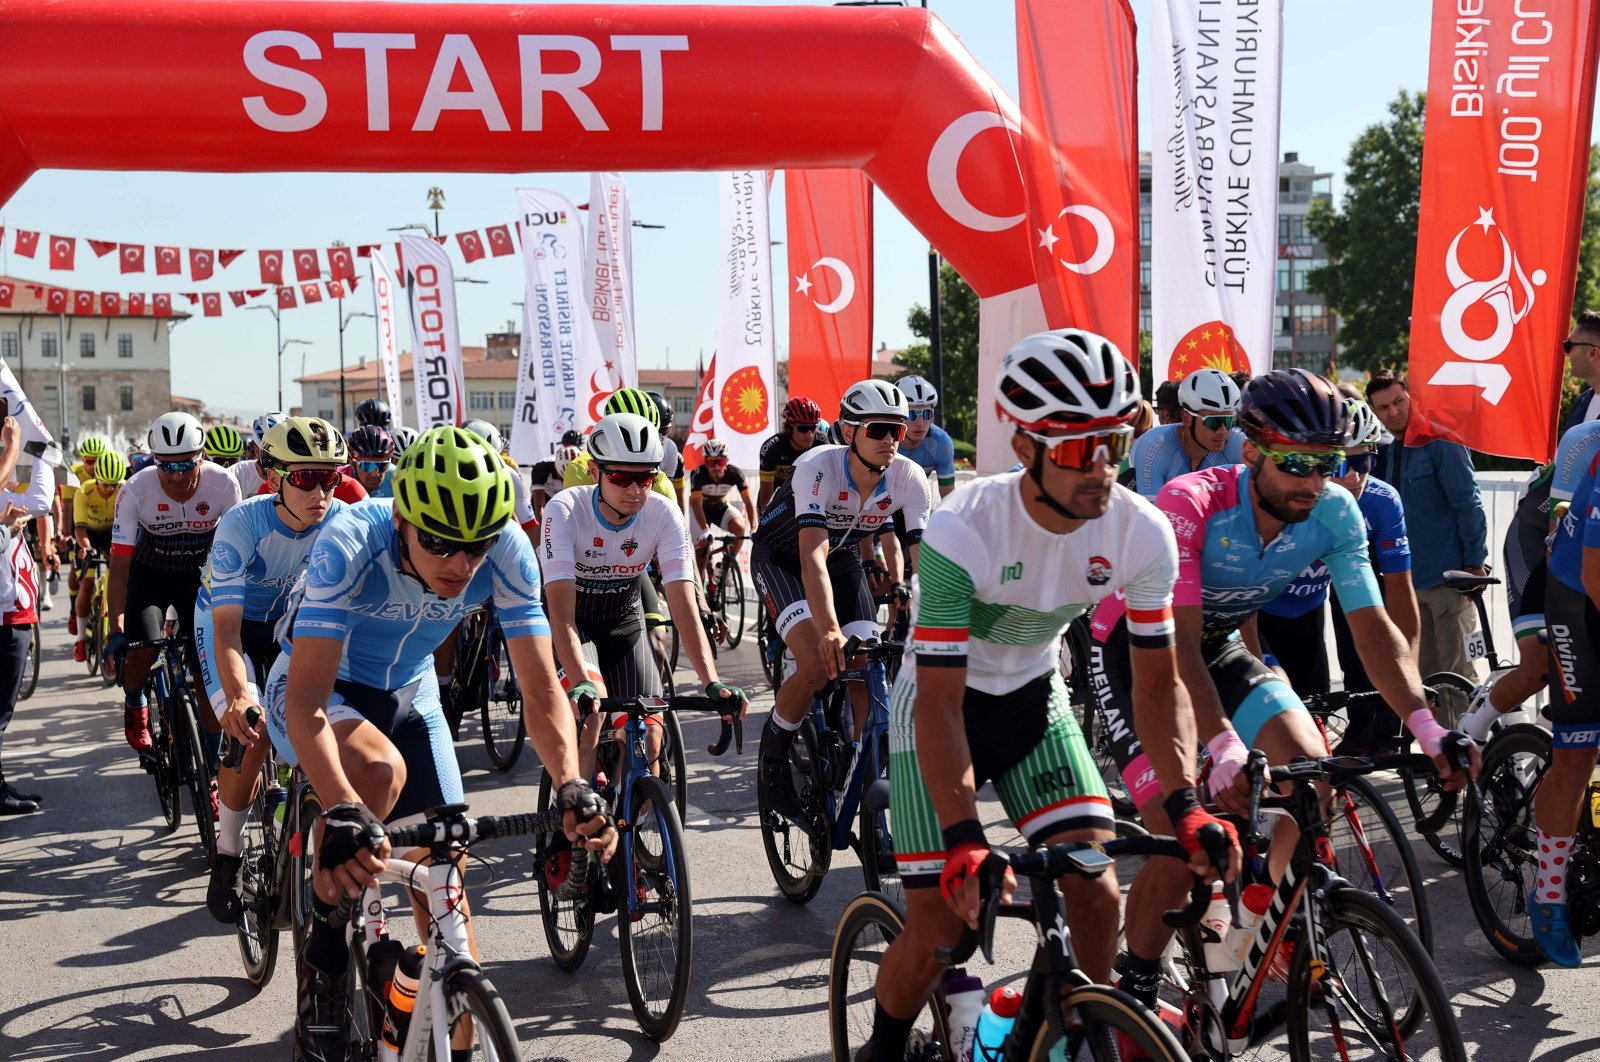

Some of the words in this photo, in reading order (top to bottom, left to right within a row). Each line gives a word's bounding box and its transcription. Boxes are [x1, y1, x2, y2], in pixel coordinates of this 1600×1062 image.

[242, 30, 690, 133] START
[1468, 640, 1484, 659] 95
[1551, 624, 1583, 694] Divinol
[1090, 645, 1130, 743] MEILAN
[1560, 730, 1600, 744] VBT
